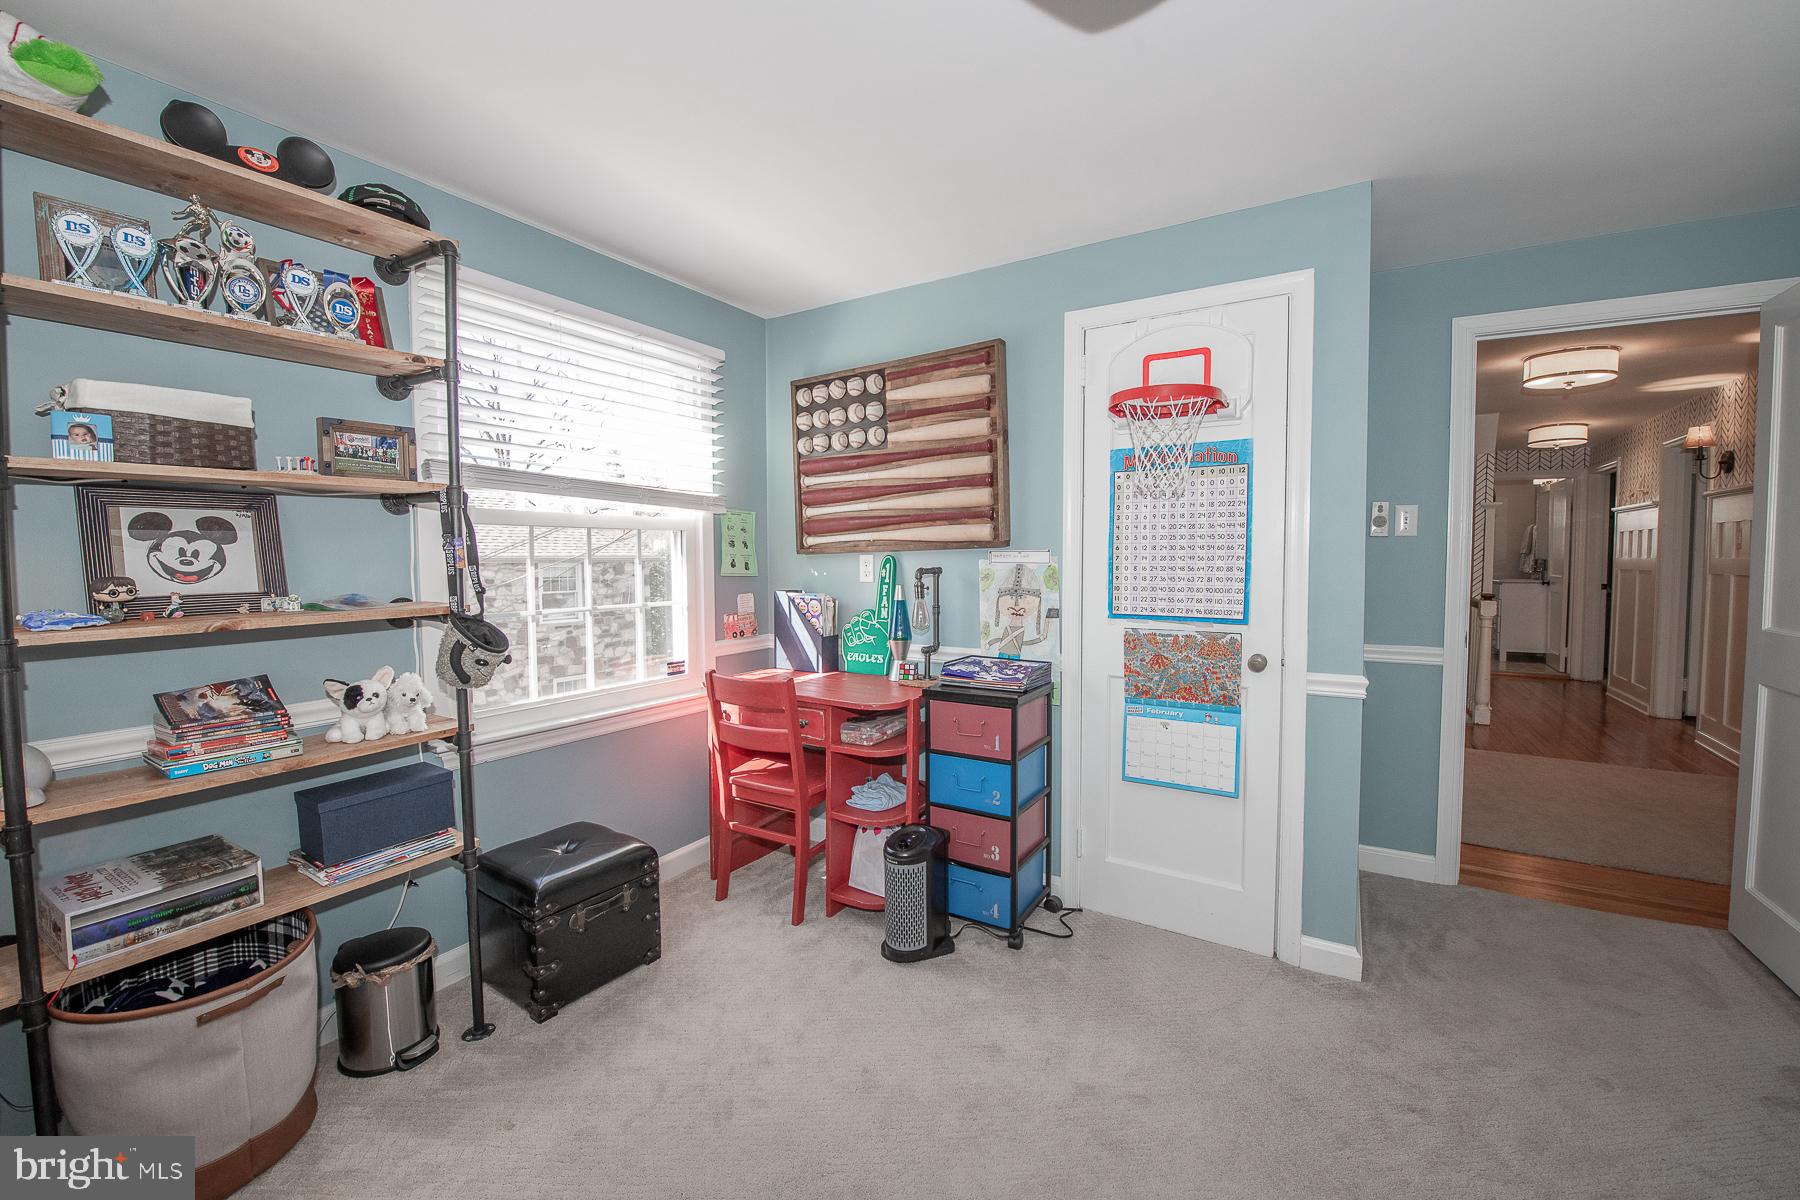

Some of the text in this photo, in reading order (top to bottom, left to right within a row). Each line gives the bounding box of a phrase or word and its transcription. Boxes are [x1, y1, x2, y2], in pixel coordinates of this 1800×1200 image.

[881, 563, 890, 583] #1
[847, 652, 884, 664] EAGLES
[1146, 708, 1184, 718] February
[202, 762, 218, 770] DOG
[992, 790, 1001, 806] 2
[991, 845, 1000, 861] 3
[989, 903, 1000, 919] 4
